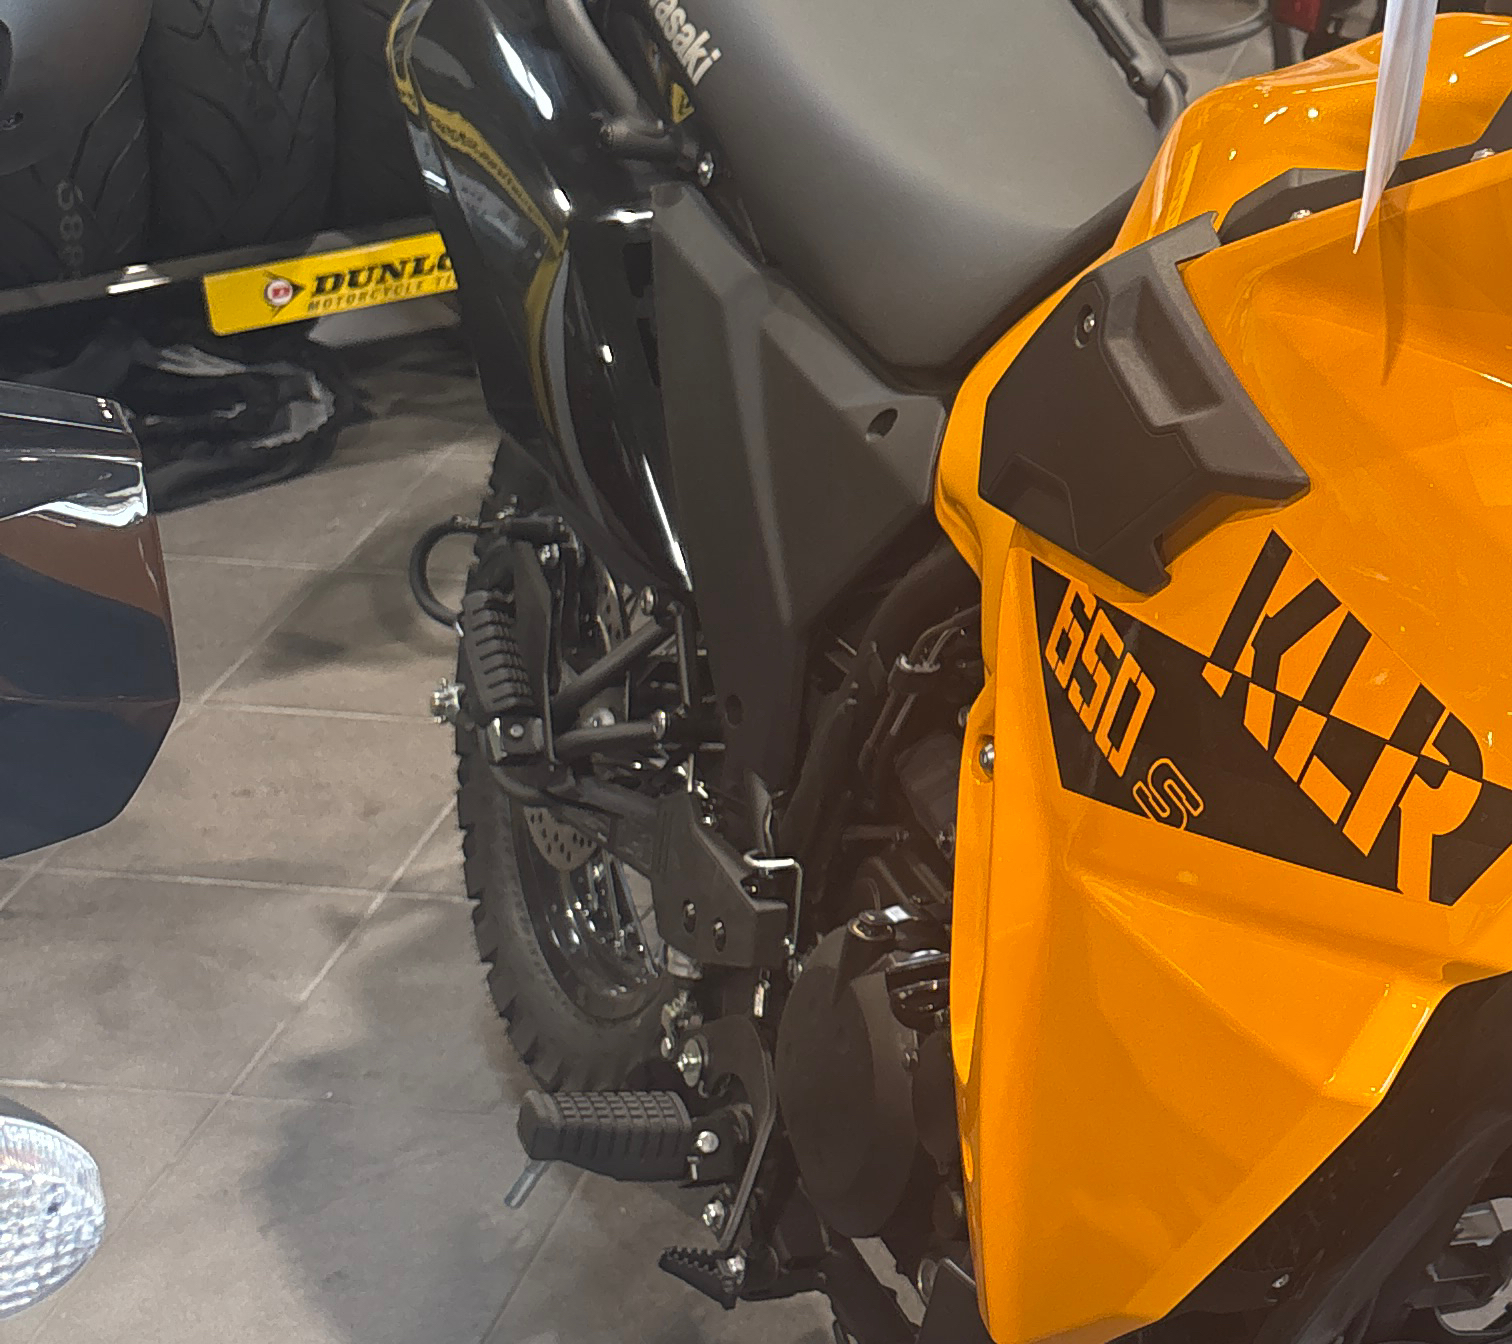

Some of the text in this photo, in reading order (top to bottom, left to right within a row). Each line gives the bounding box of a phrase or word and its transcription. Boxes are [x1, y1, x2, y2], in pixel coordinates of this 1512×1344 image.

[307, 280, 423, 312] MOTORCYCLE
[1044, 580, 1204, 831] 650 S
[1201, 529, 1484, 906] KLR
